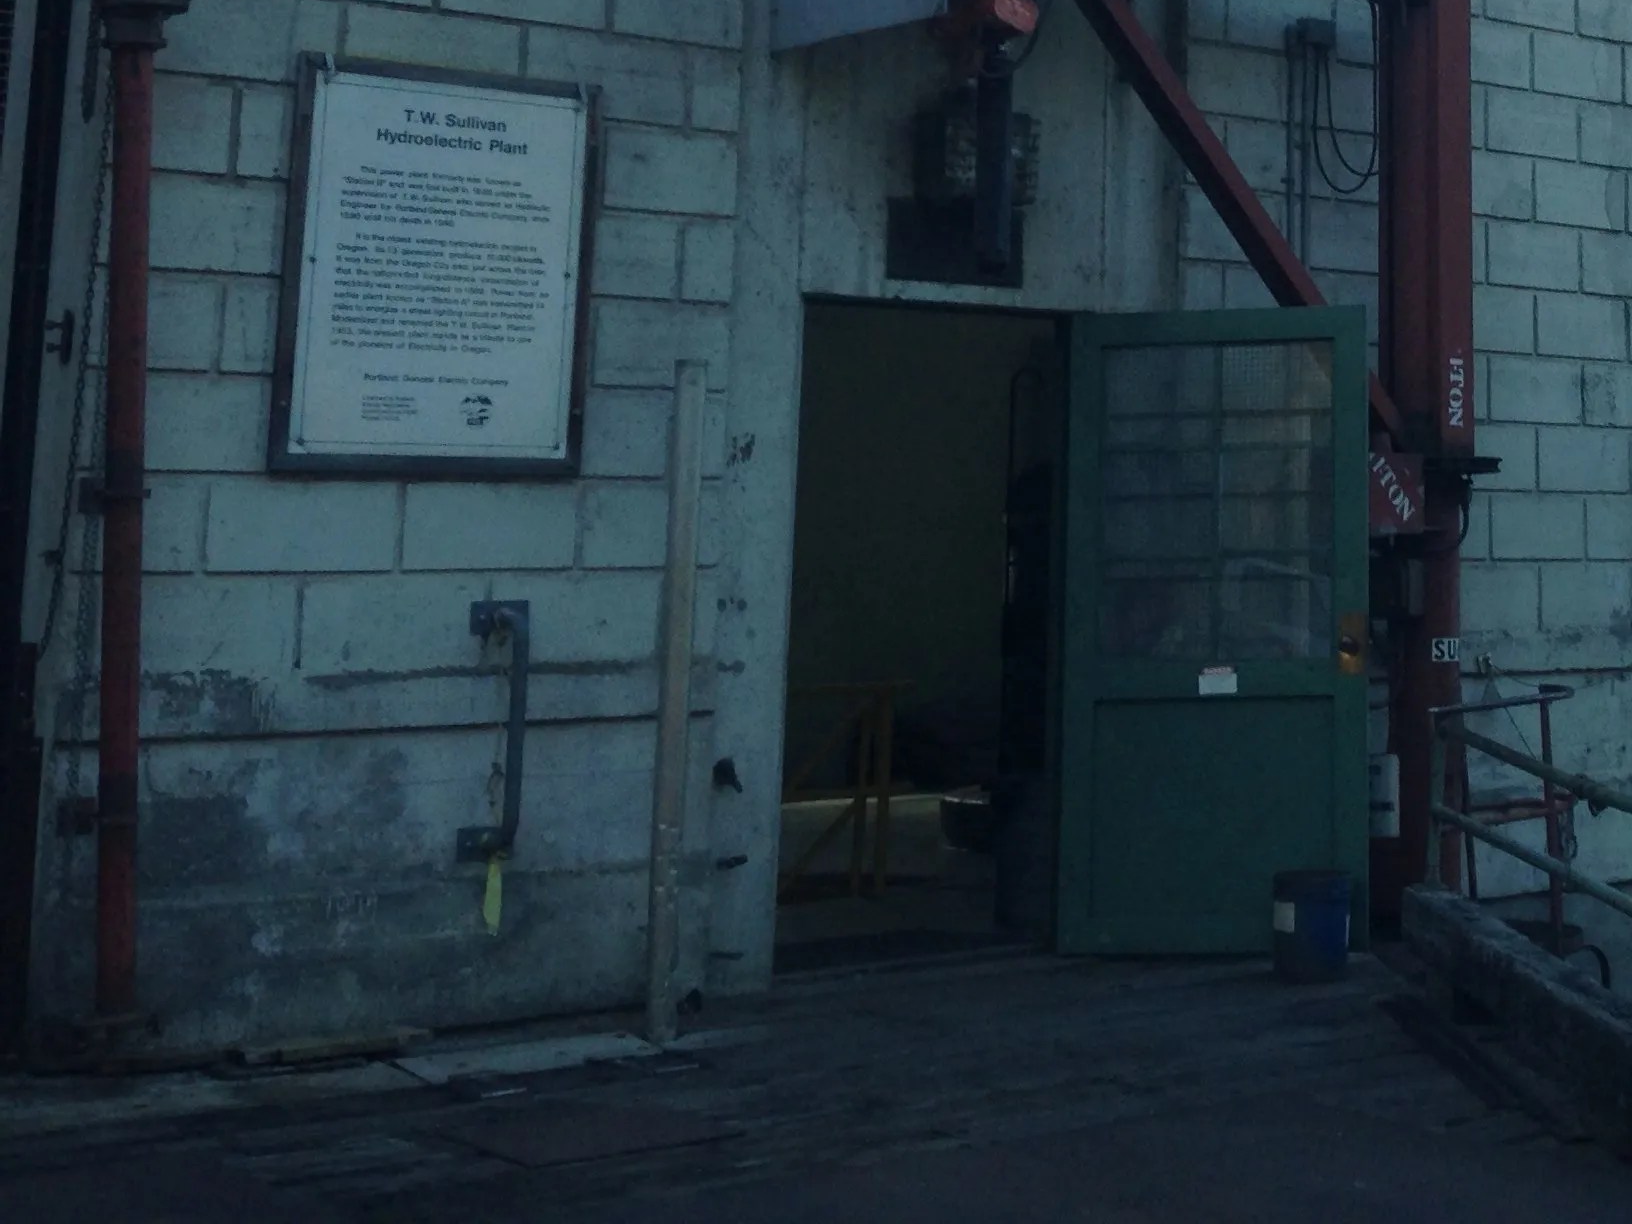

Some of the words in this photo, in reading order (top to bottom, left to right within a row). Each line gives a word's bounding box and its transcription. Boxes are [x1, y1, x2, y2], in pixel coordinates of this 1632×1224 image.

[444, 113, 507, 132] Sullivan
[376, 128, 482, 151] Hydroelectric
[489, 138, 528, 155] Plant
